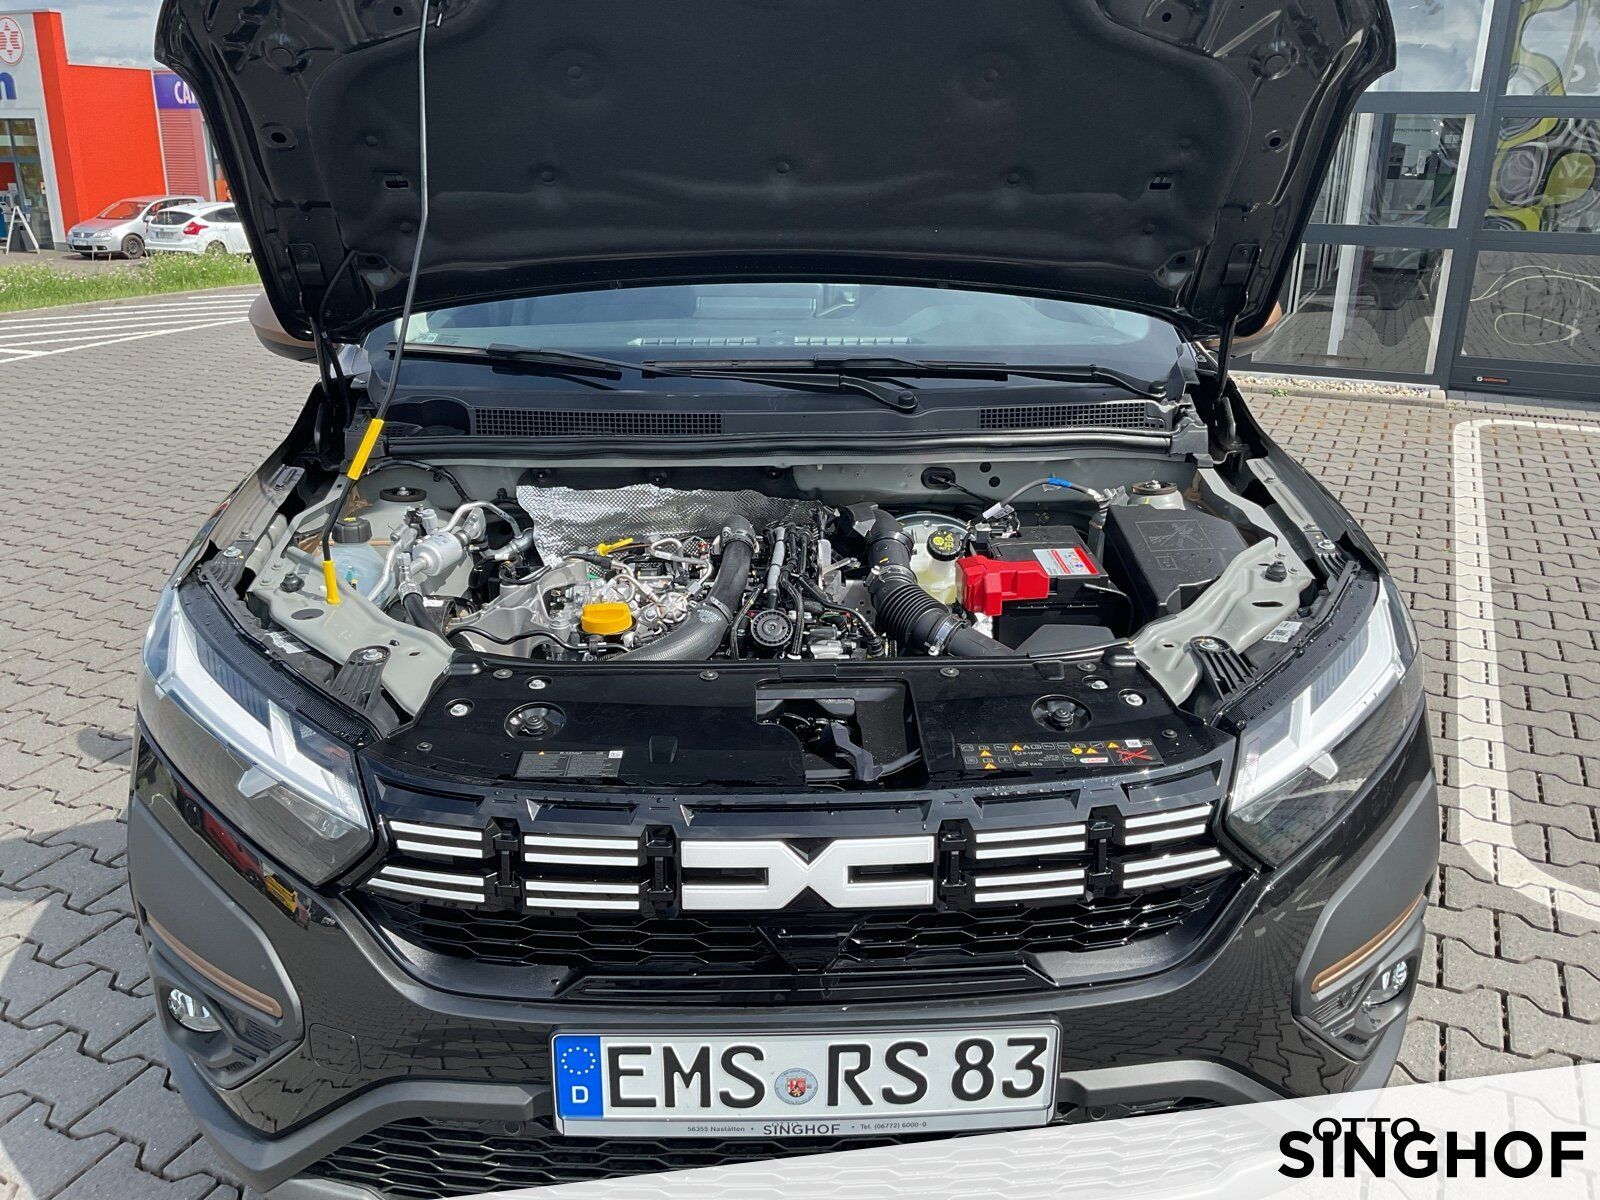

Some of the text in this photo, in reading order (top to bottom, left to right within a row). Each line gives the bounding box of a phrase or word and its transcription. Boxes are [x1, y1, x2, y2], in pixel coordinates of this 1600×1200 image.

[607, 1037, 1048, 1109] EMS RS 83
[572, 1086, 589, 1103] D
[763, 1124, 841, 1135] SINGHOF
[874, 1122, 901, 1130] (06772)
[901, 1121, 927, 1129] 6000-0
